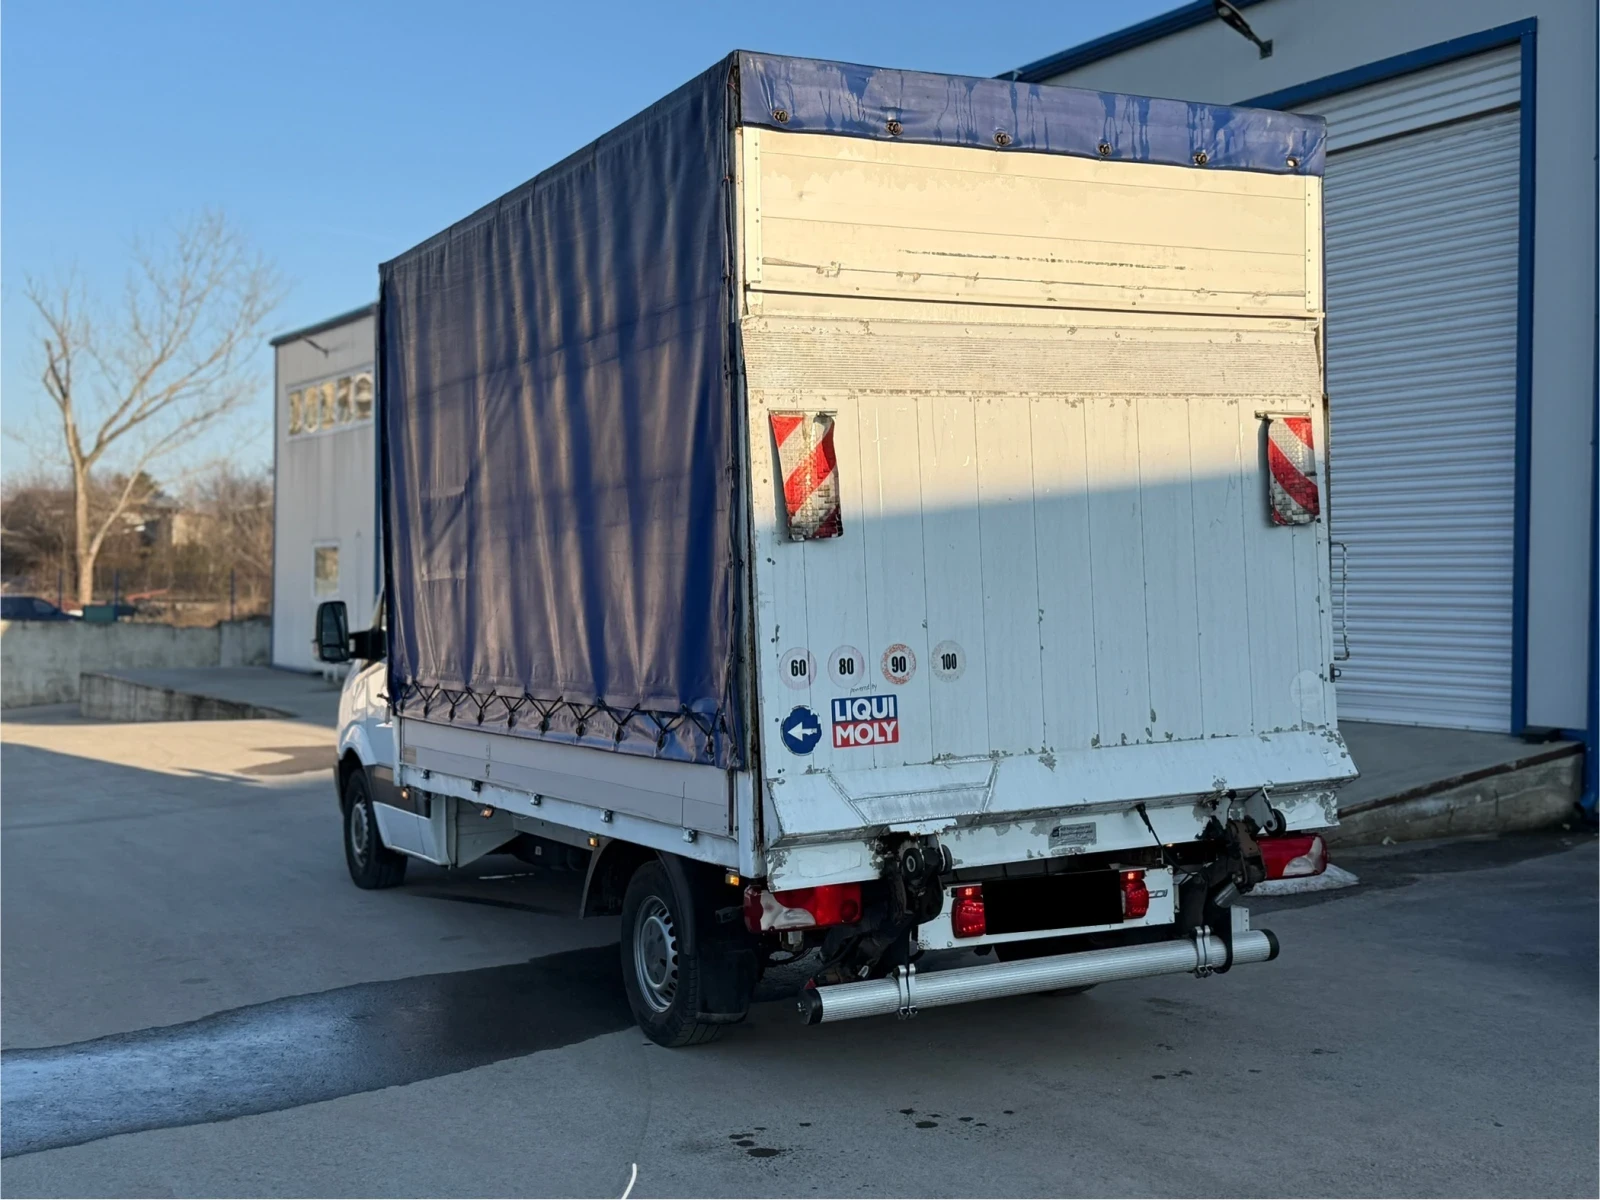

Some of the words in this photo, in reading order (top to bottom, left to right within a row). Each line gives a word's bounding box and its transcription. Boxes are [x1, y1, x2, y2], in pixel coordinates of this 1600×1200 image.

[791, 659, 806, 677] 60
[839, 657, 855, 675] 80
[891, 656, 907, 673] 90
[941, 653, 957, 670] 100
[835, 696, 895, 721] LIQUI
[836, 721, 897, 746] MOLY
